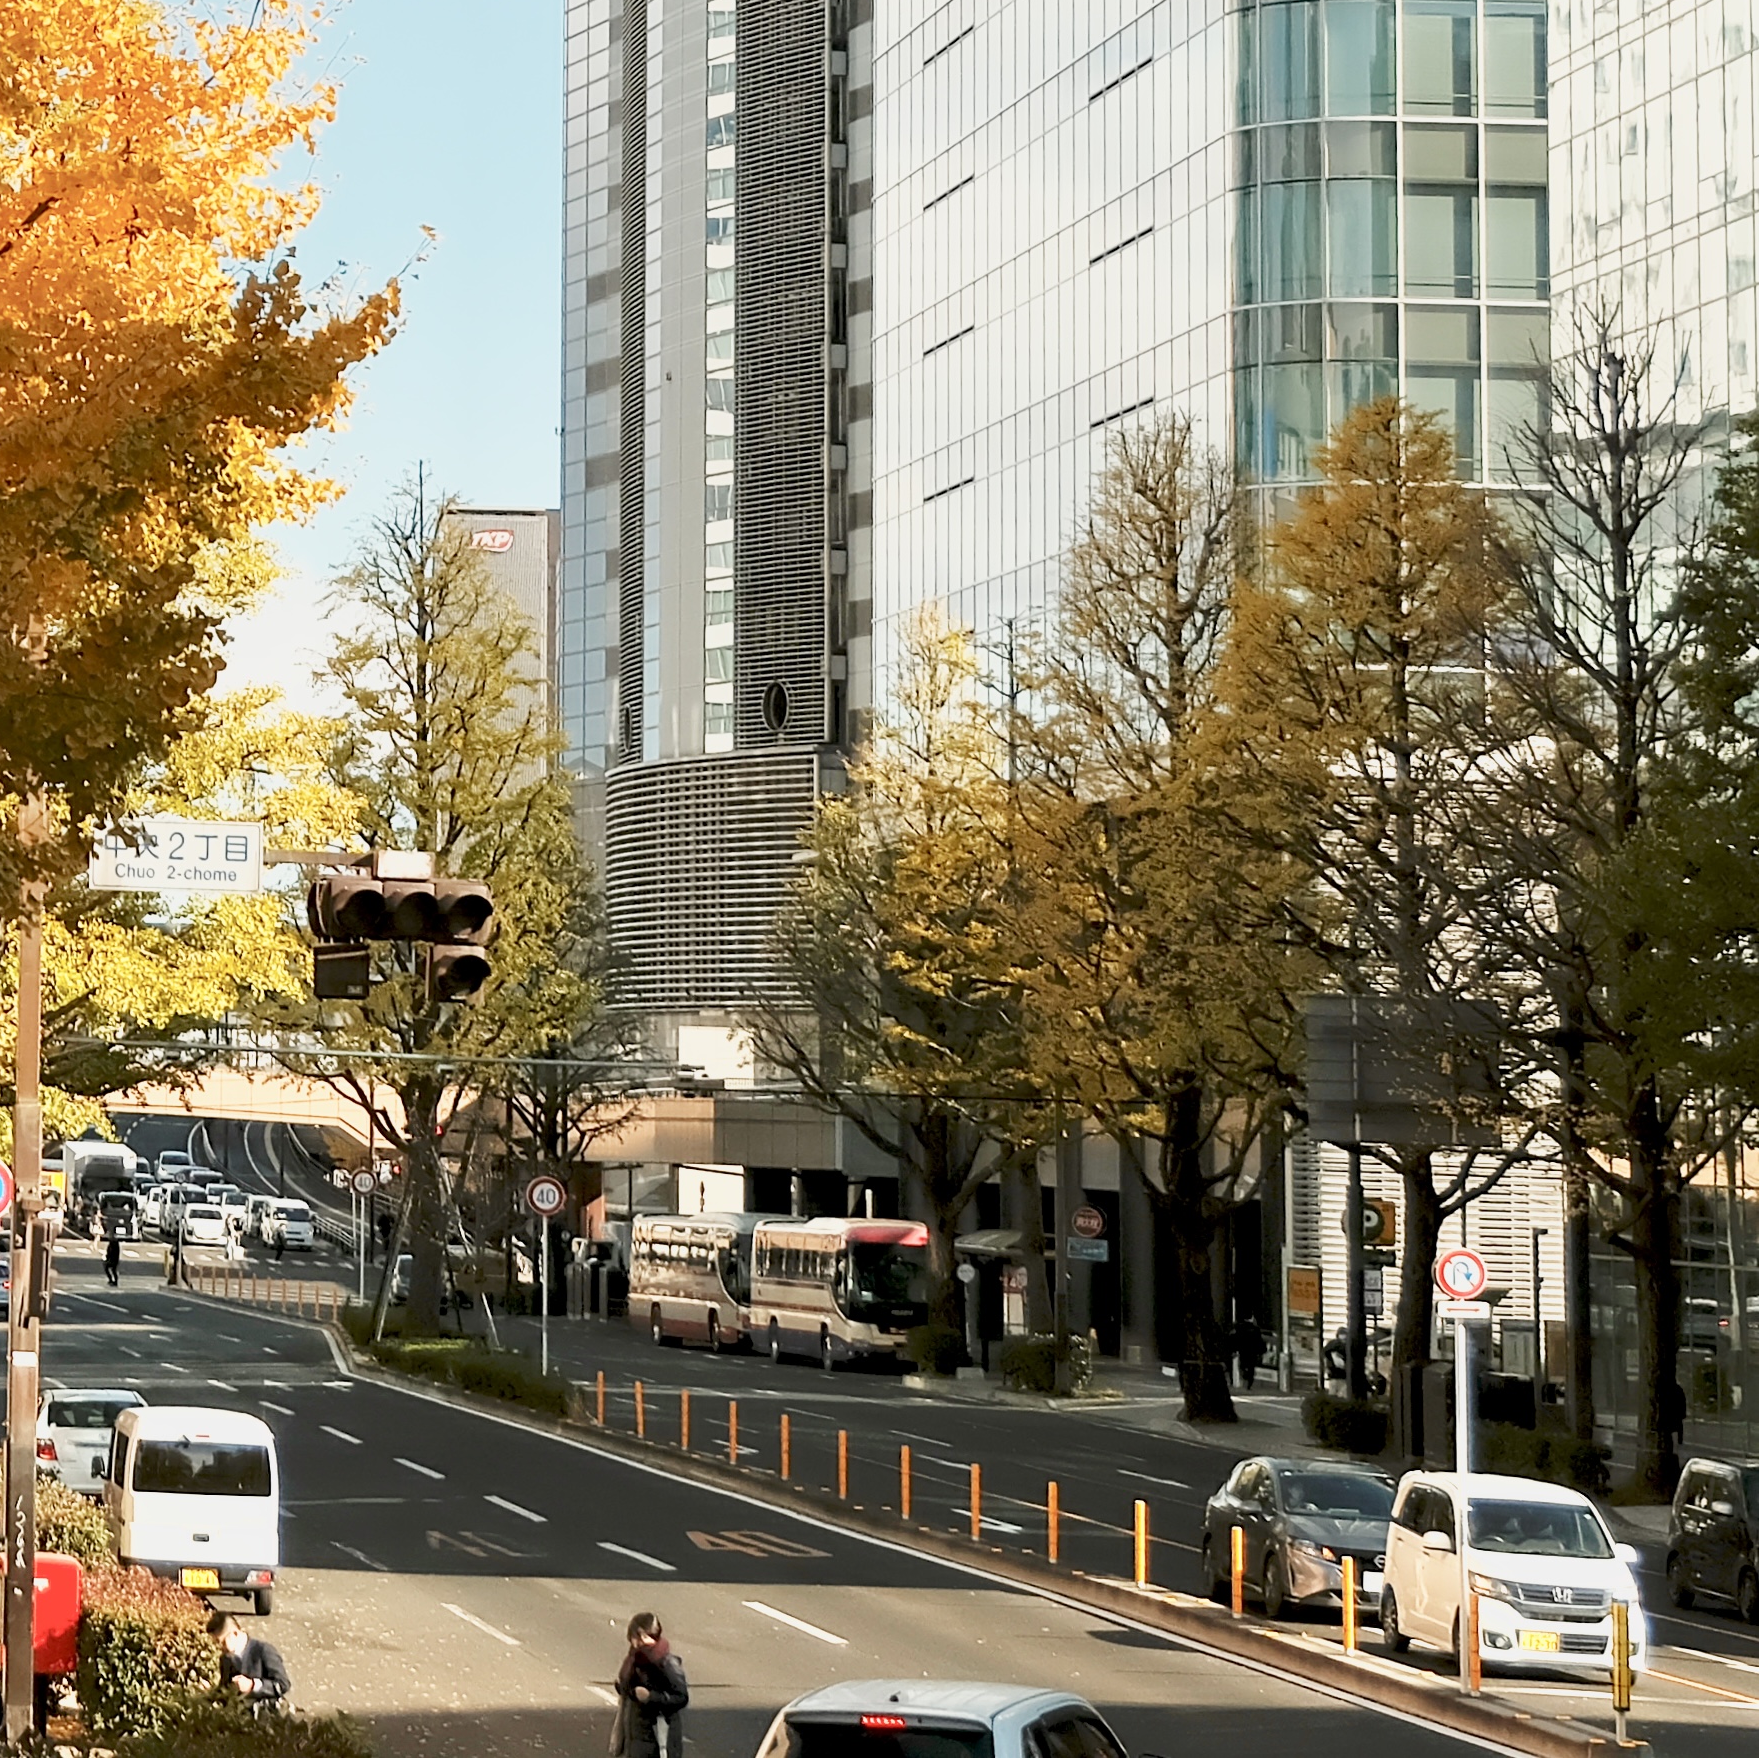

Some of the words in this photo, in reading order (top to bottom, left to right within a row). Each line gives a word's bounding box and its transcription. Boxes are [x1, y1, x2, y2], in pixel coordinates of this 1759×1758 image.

[471, 531, 510, 547] TKP
[114, 862, 155, 880] Chuo
[167, 864, 237, 882] 2-chome
[358, 1176, 371, 1187] 40
[536, 1188, 556, 1206] 40
